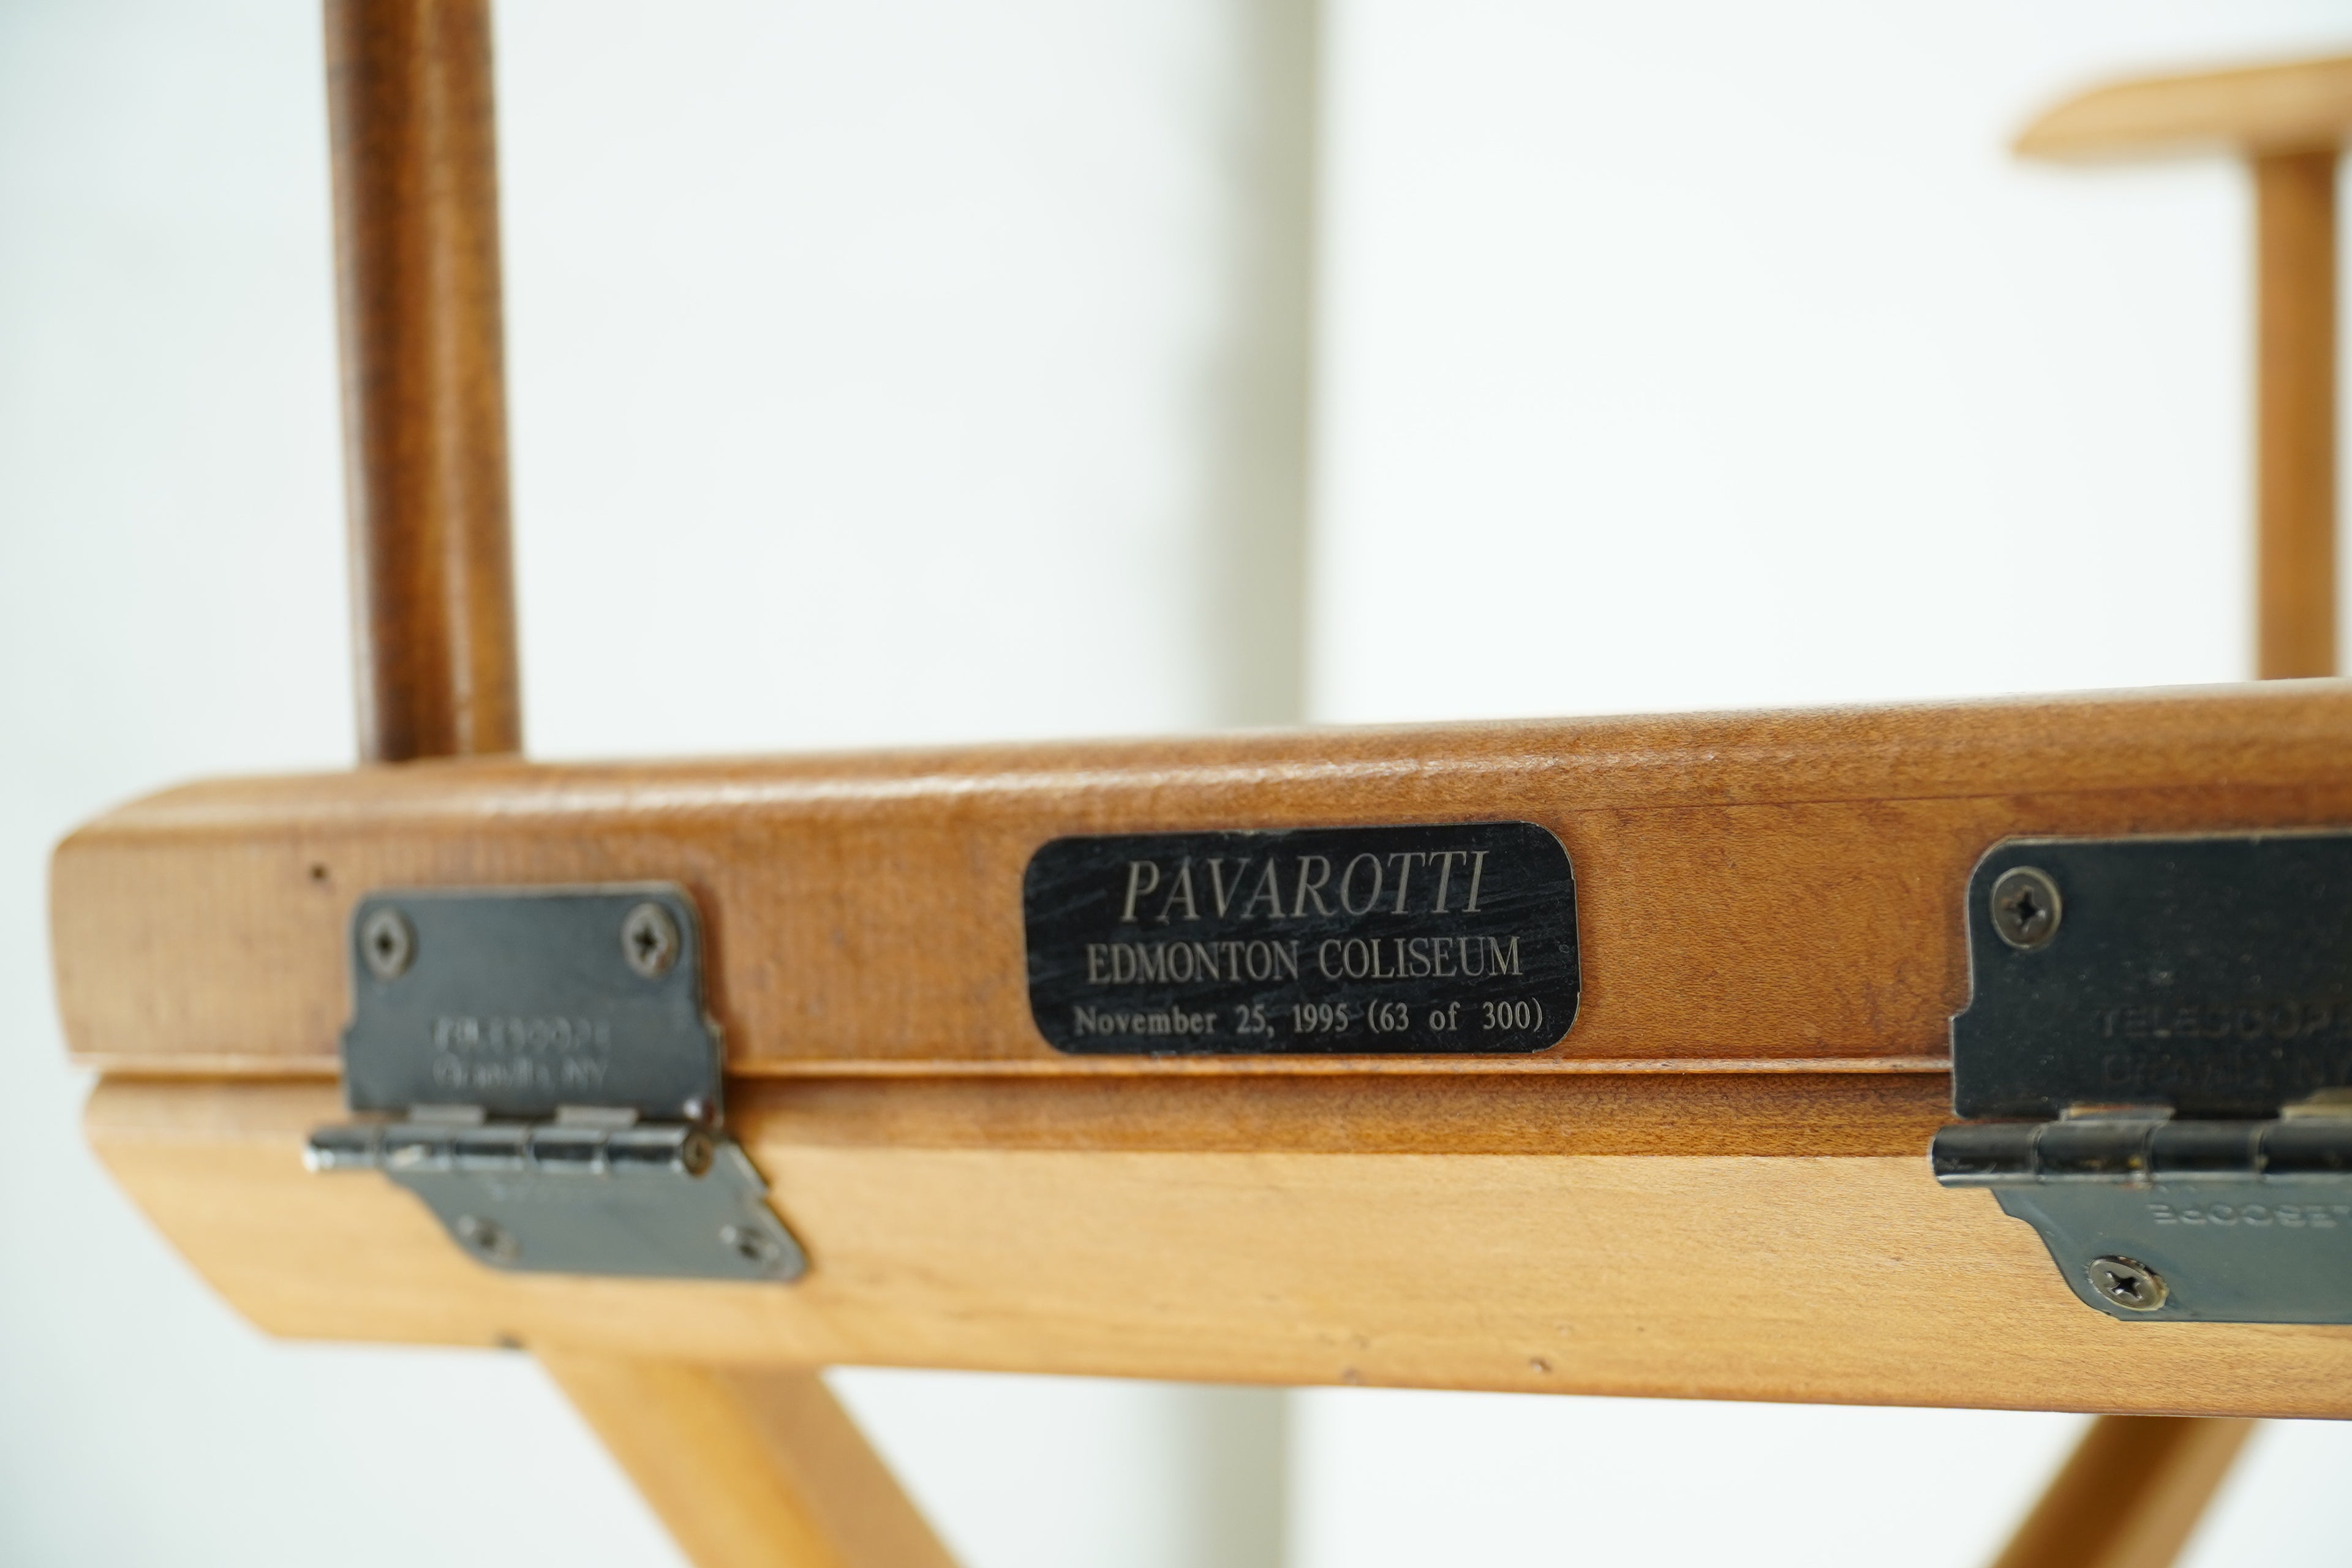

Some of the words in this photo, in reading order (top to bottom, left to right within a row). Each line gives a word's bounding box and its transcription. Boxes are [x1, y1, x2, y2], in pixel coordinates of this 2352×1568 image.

[1121, 850, 1490, 922] PAVAROTTI
[1086, 939, 1300, 985] EDMONTON
[1319, 935, 1524, 979] COLISEUM
[1072, 1003, 1218, 1036] November
[1234, 1003, 1275, 1038] 25,
[1292, 1002, 1348, 1034] 1995
[1368, 998, 1409, 1035] (63
[1428, 1000, 1461, 1031] of
[1482, 996, 1542, 1033] 300)
